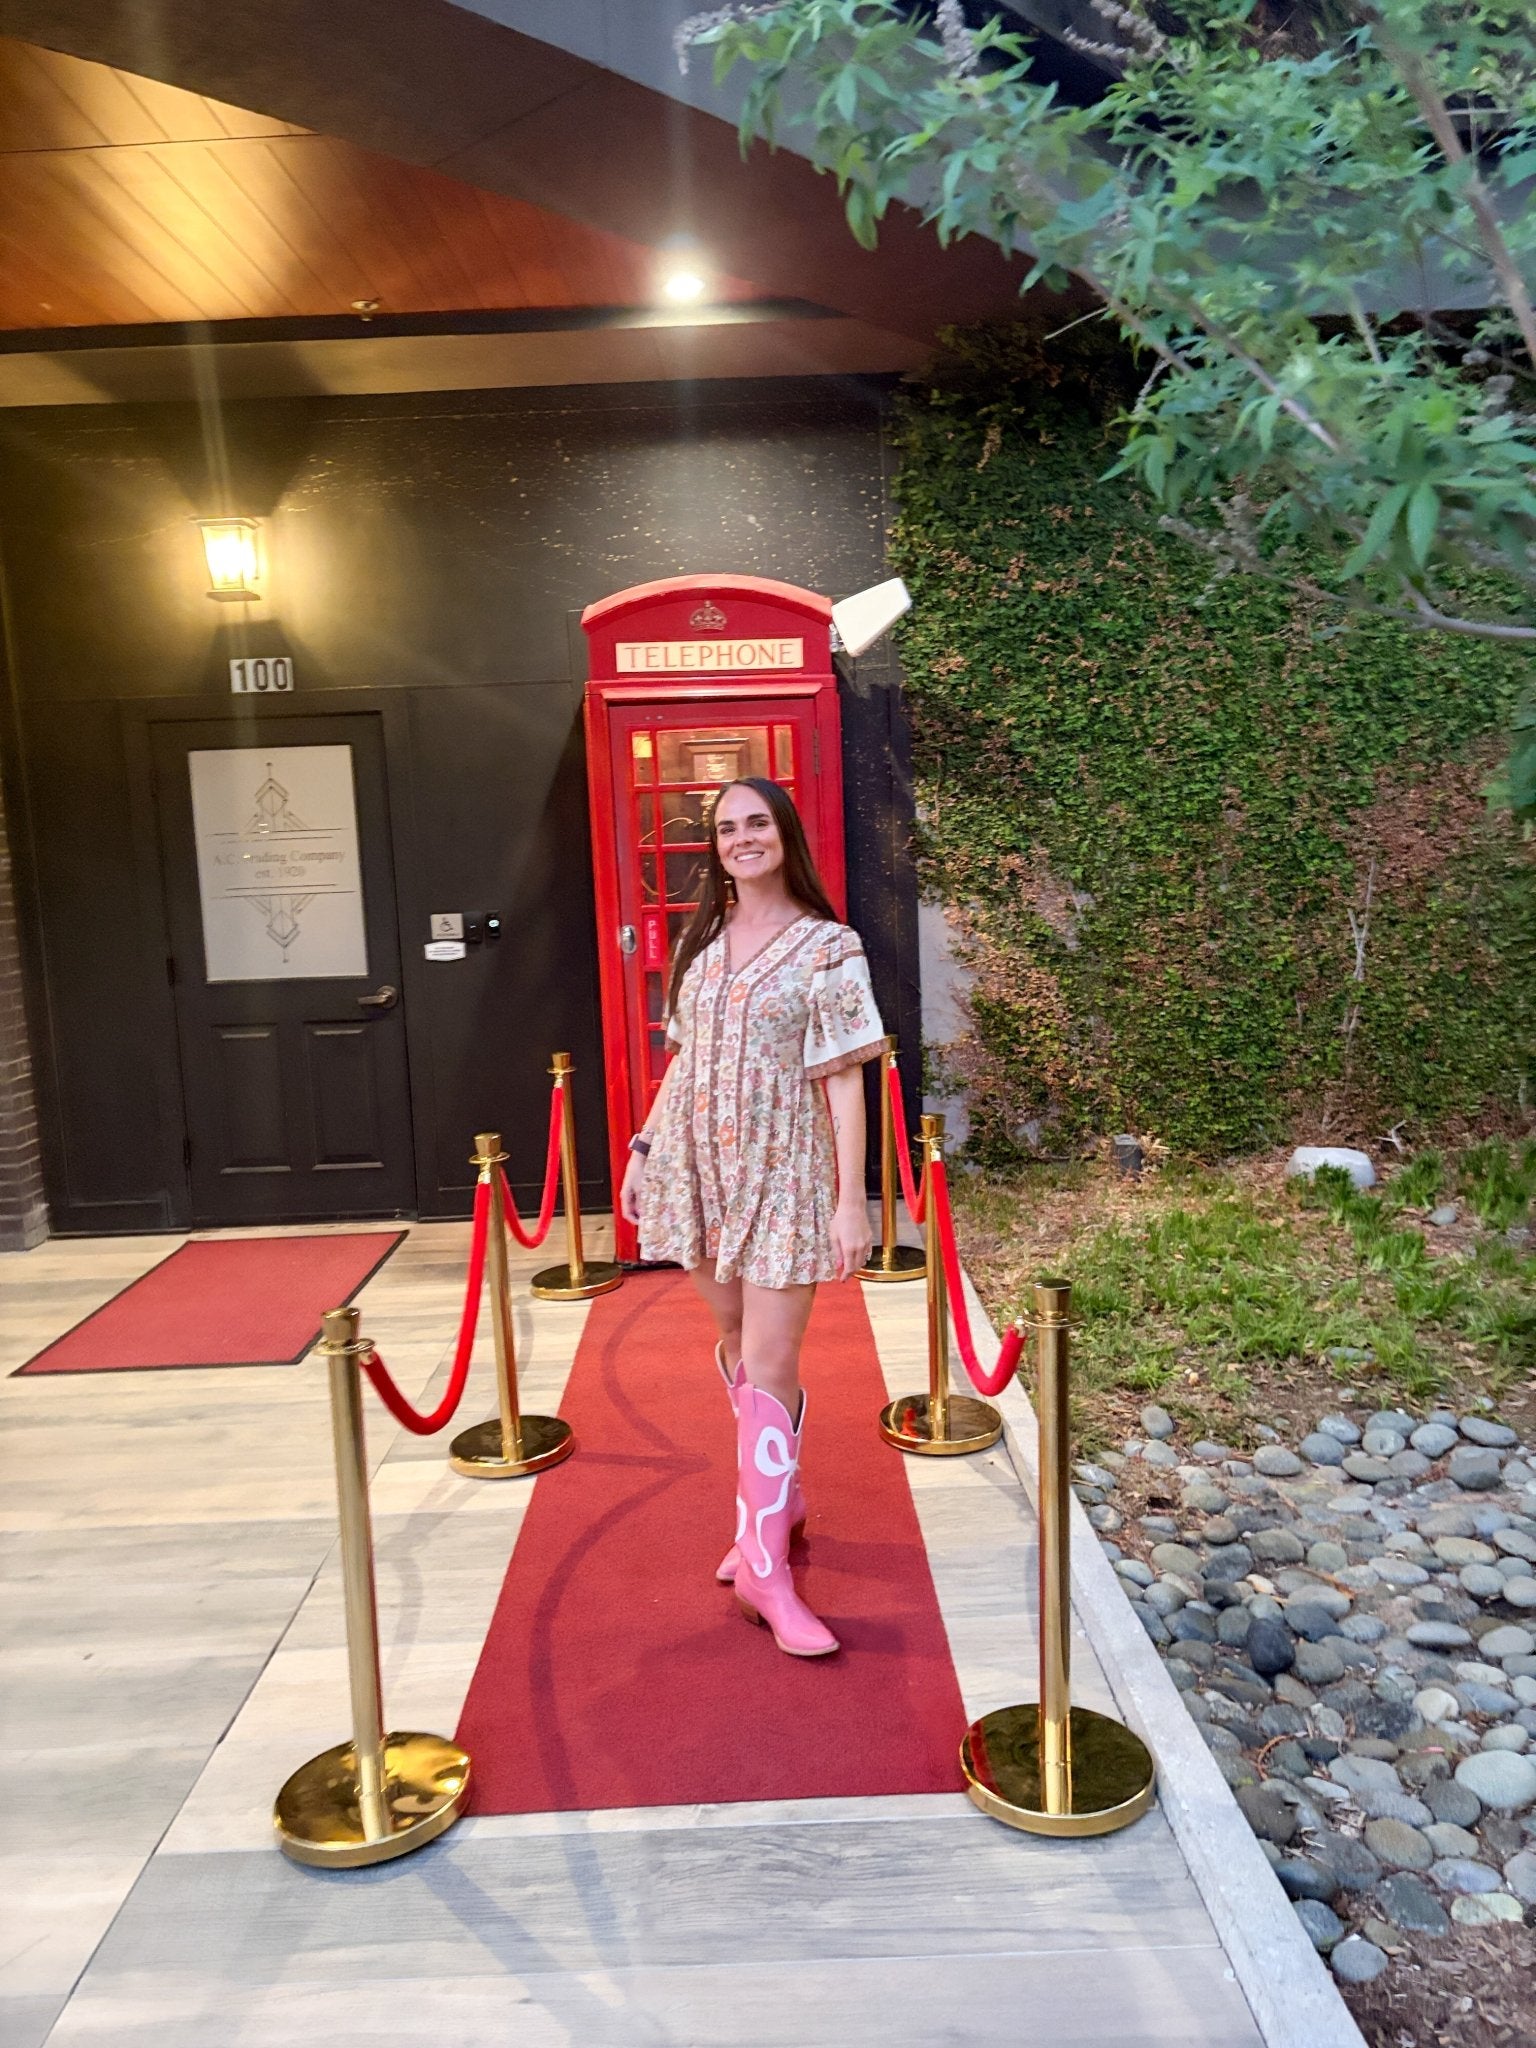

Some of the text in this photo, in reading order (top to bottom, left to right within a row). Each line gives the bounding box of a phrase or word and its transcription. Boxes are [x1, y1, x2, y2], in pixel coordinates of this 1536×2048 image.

[624, 642, 795, 669] TELEPHONE
[234, 658, 289, 692] 100
[290, 849, 346, 864] Company
[647, 919, 658, 960] PULL
